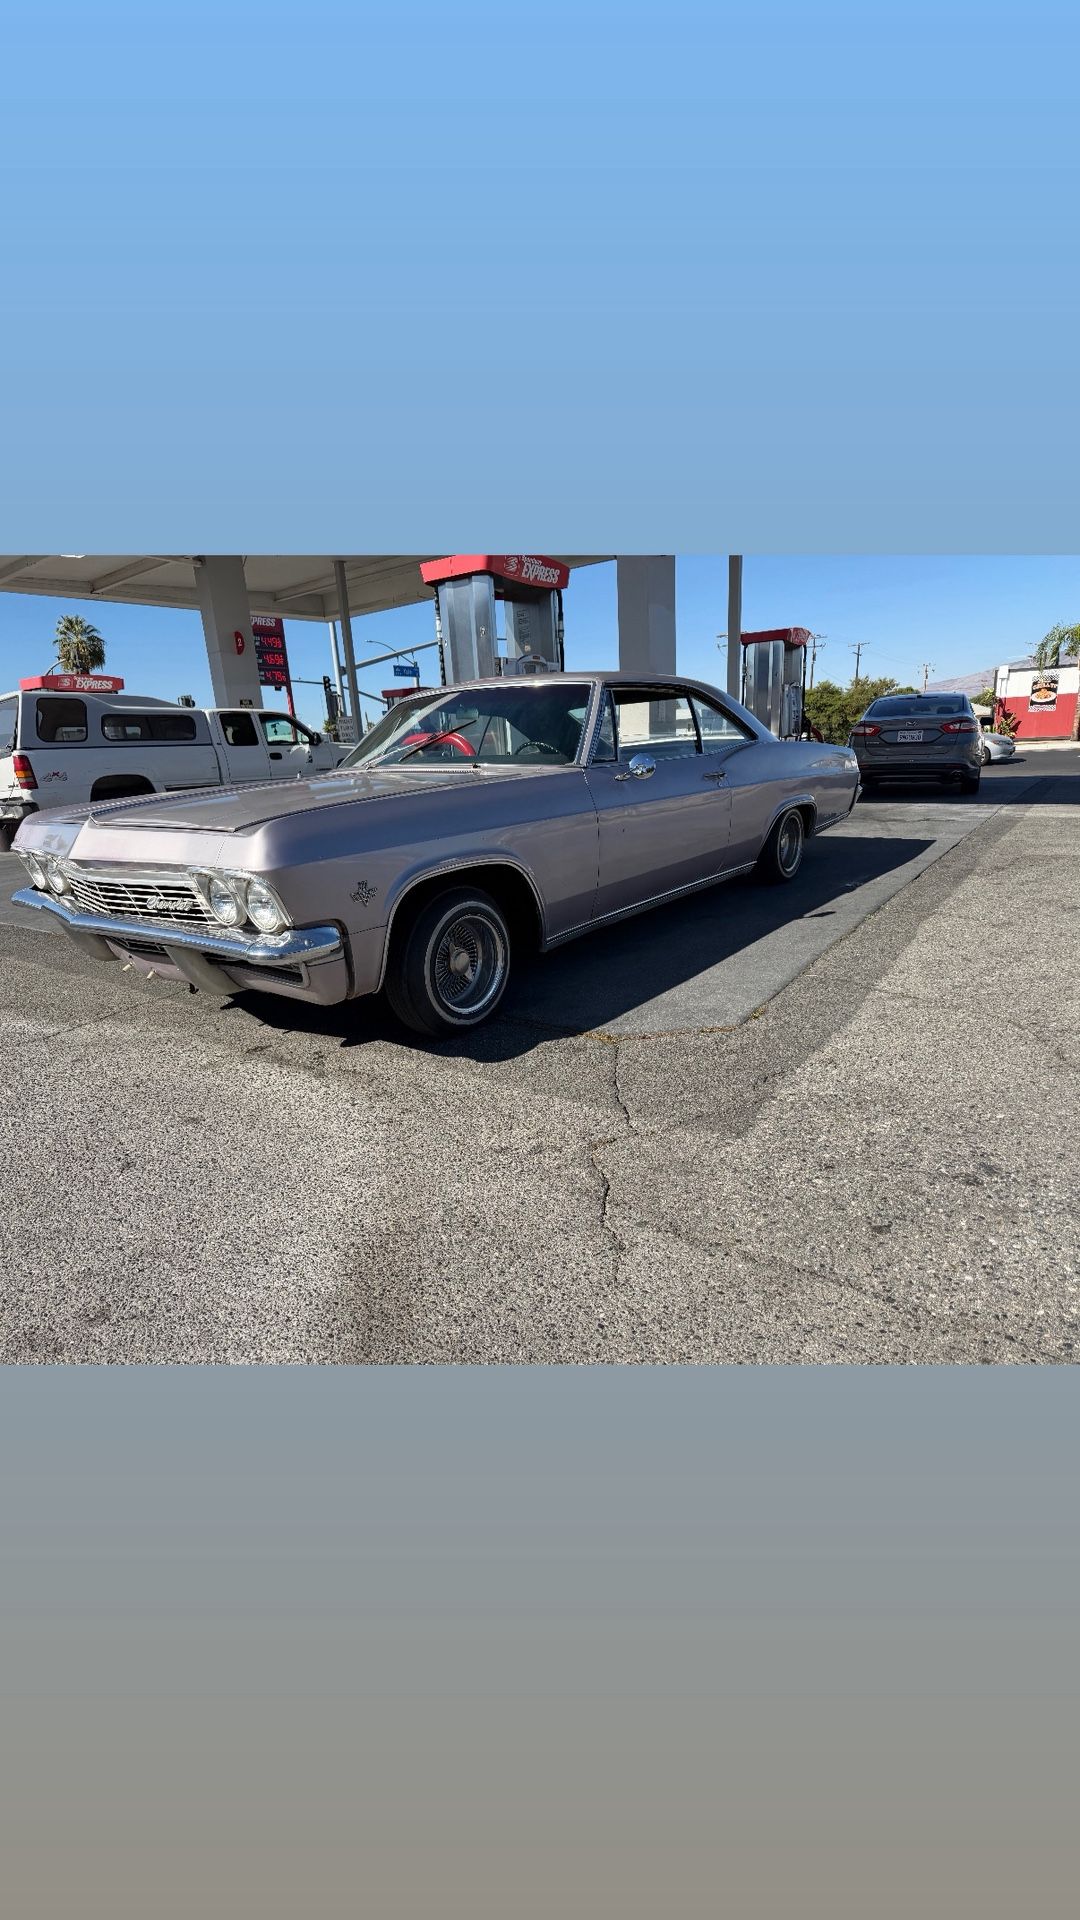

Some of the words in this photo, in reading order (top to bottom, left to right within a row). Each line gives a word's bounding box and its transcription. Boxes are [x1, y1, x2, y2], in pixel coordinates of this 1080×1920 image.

[521, 562, 560, 584] EXPRESS
[237, 638, 243, 647] 2
[75, 679, 113, 690] EXPRESS
